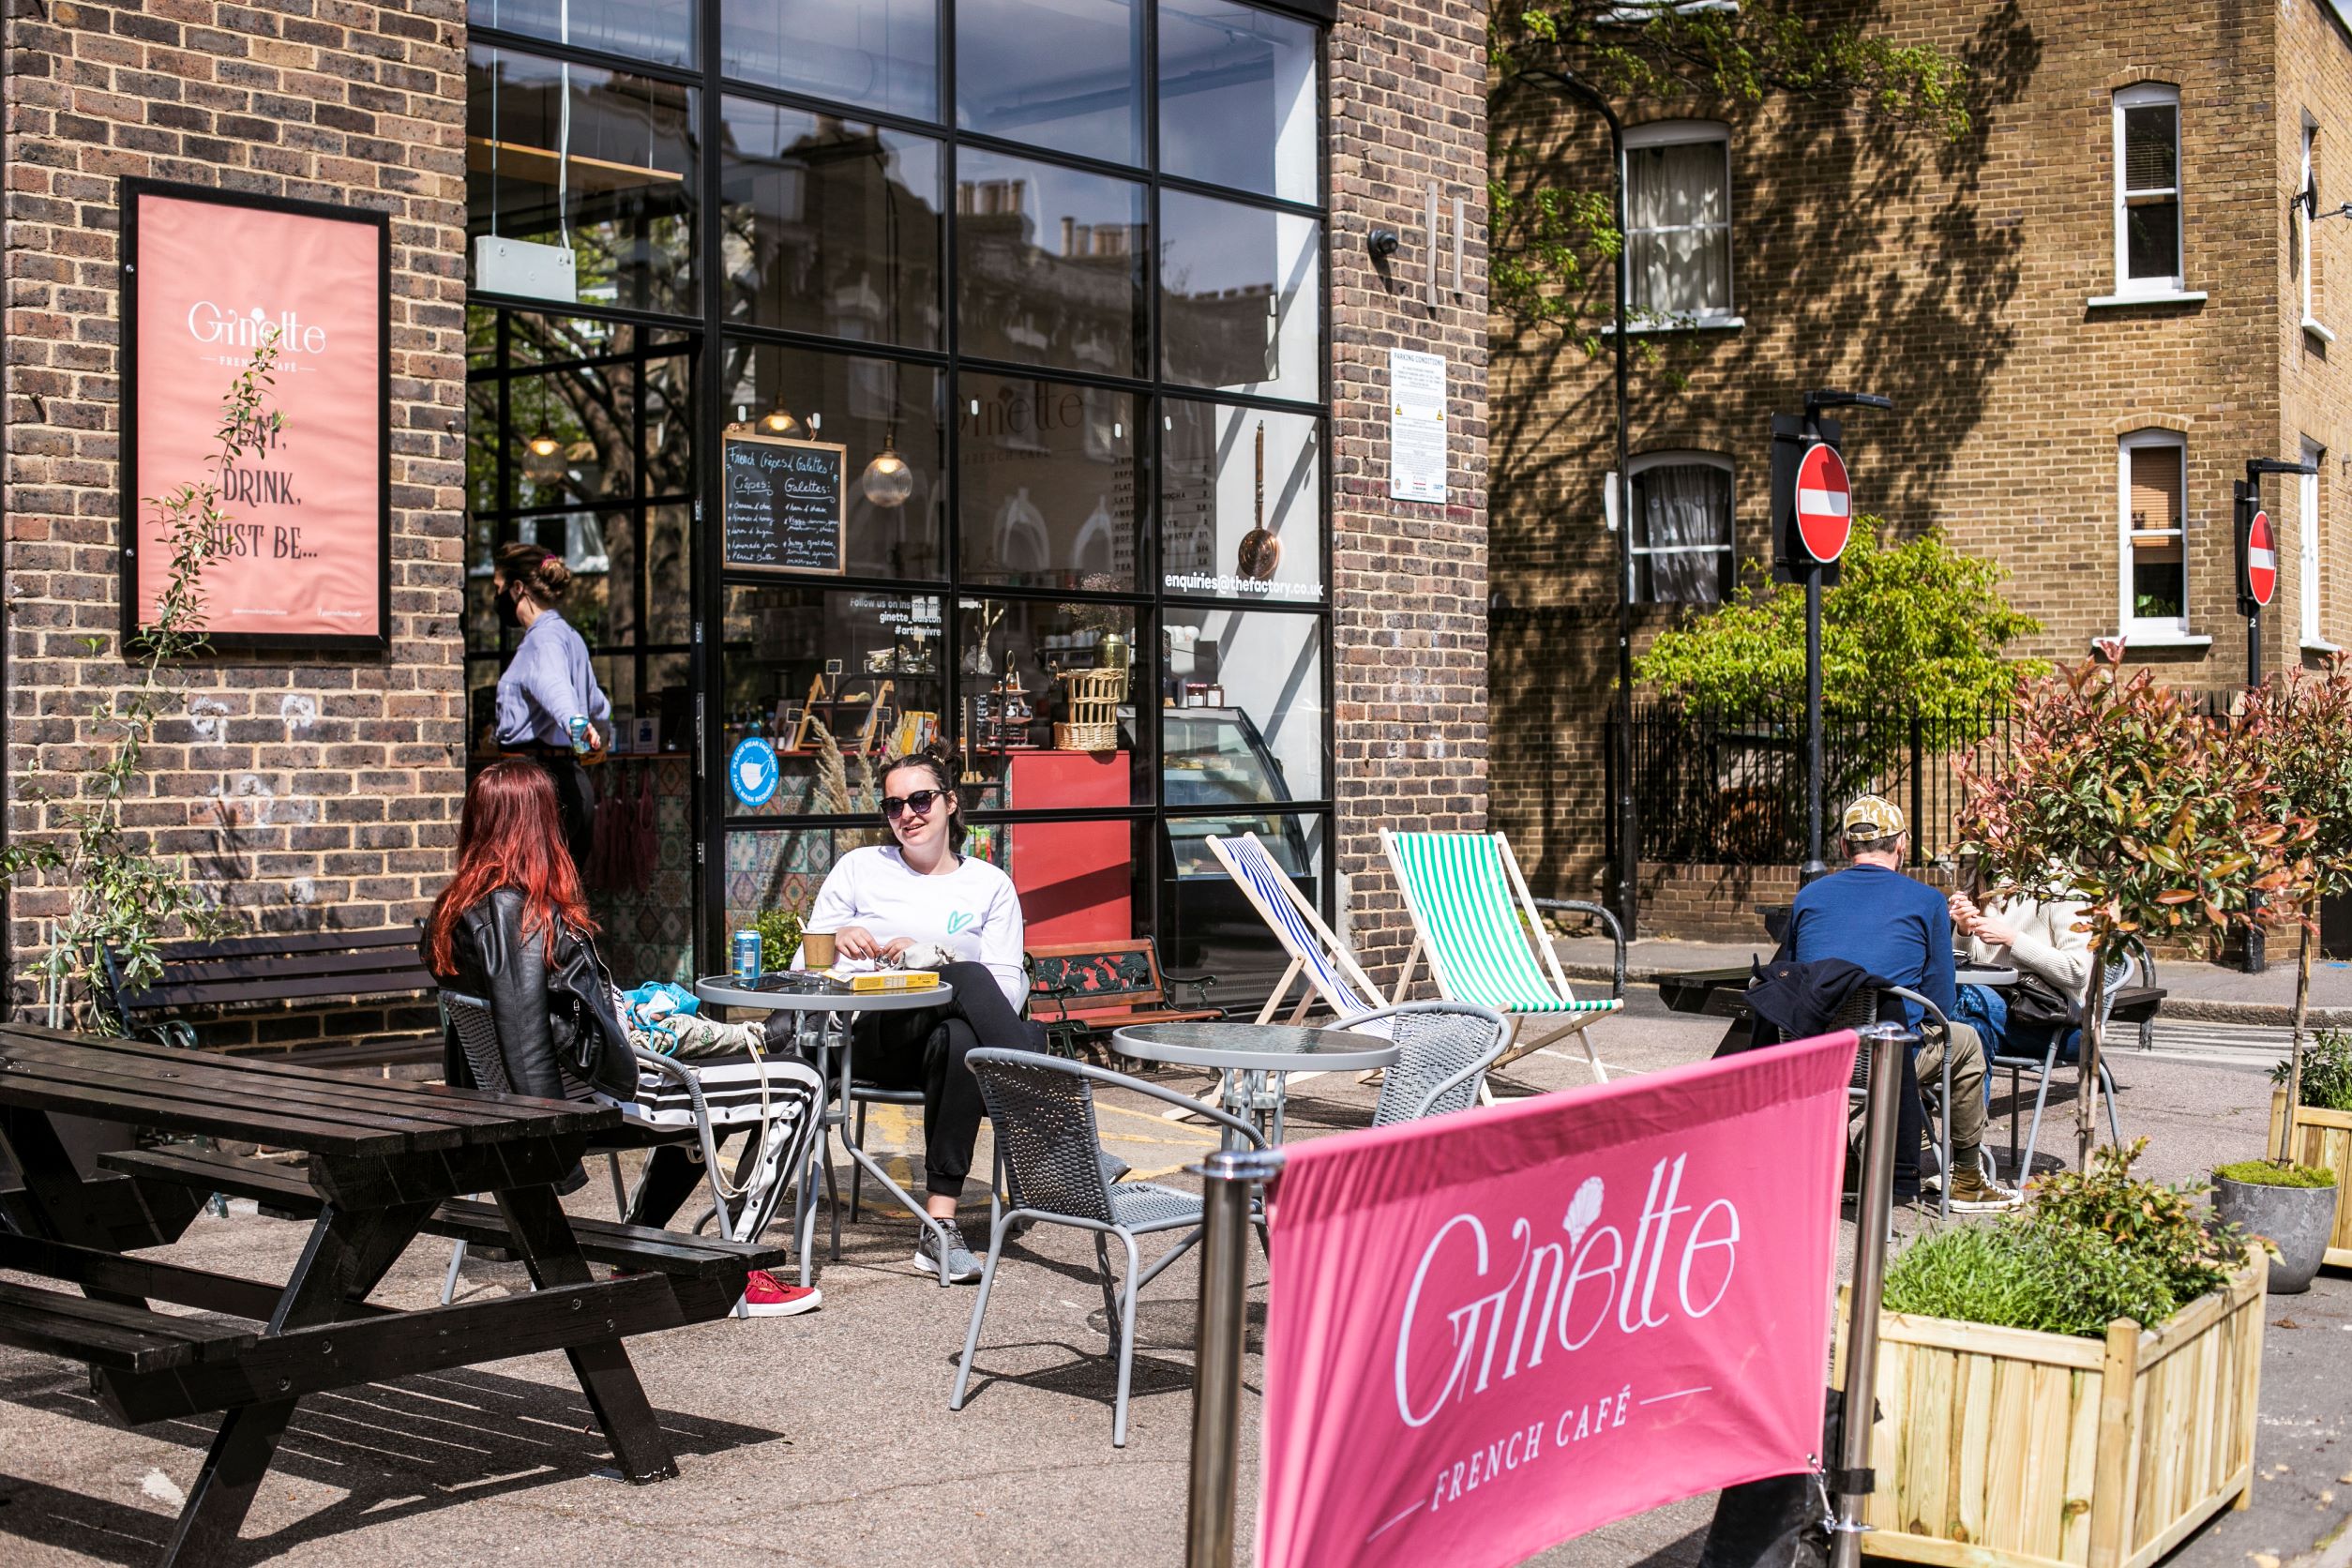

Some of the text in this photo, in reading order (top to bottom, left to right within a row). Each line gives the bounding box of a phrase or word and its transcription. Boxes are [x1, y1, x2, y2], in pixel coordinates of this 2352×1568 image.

[188, 300, 326, 354] Ginette
[728, 445, 755, 467] French
[223, 468, 301, 507] DRINK,
[274, 526, 318, 560] BE...
[1165, 572, 1324, 597] enquiries@thefactory.co.uk
[850, 597, 874, 609] Follow
[877, 600, 886, 609] us
[2249, 617, 2256, 628] 2
[1395, 1153, 1740, 1427] Ginette
[1431, 1384, 1632, 1512] FRENCH CAFÉ
